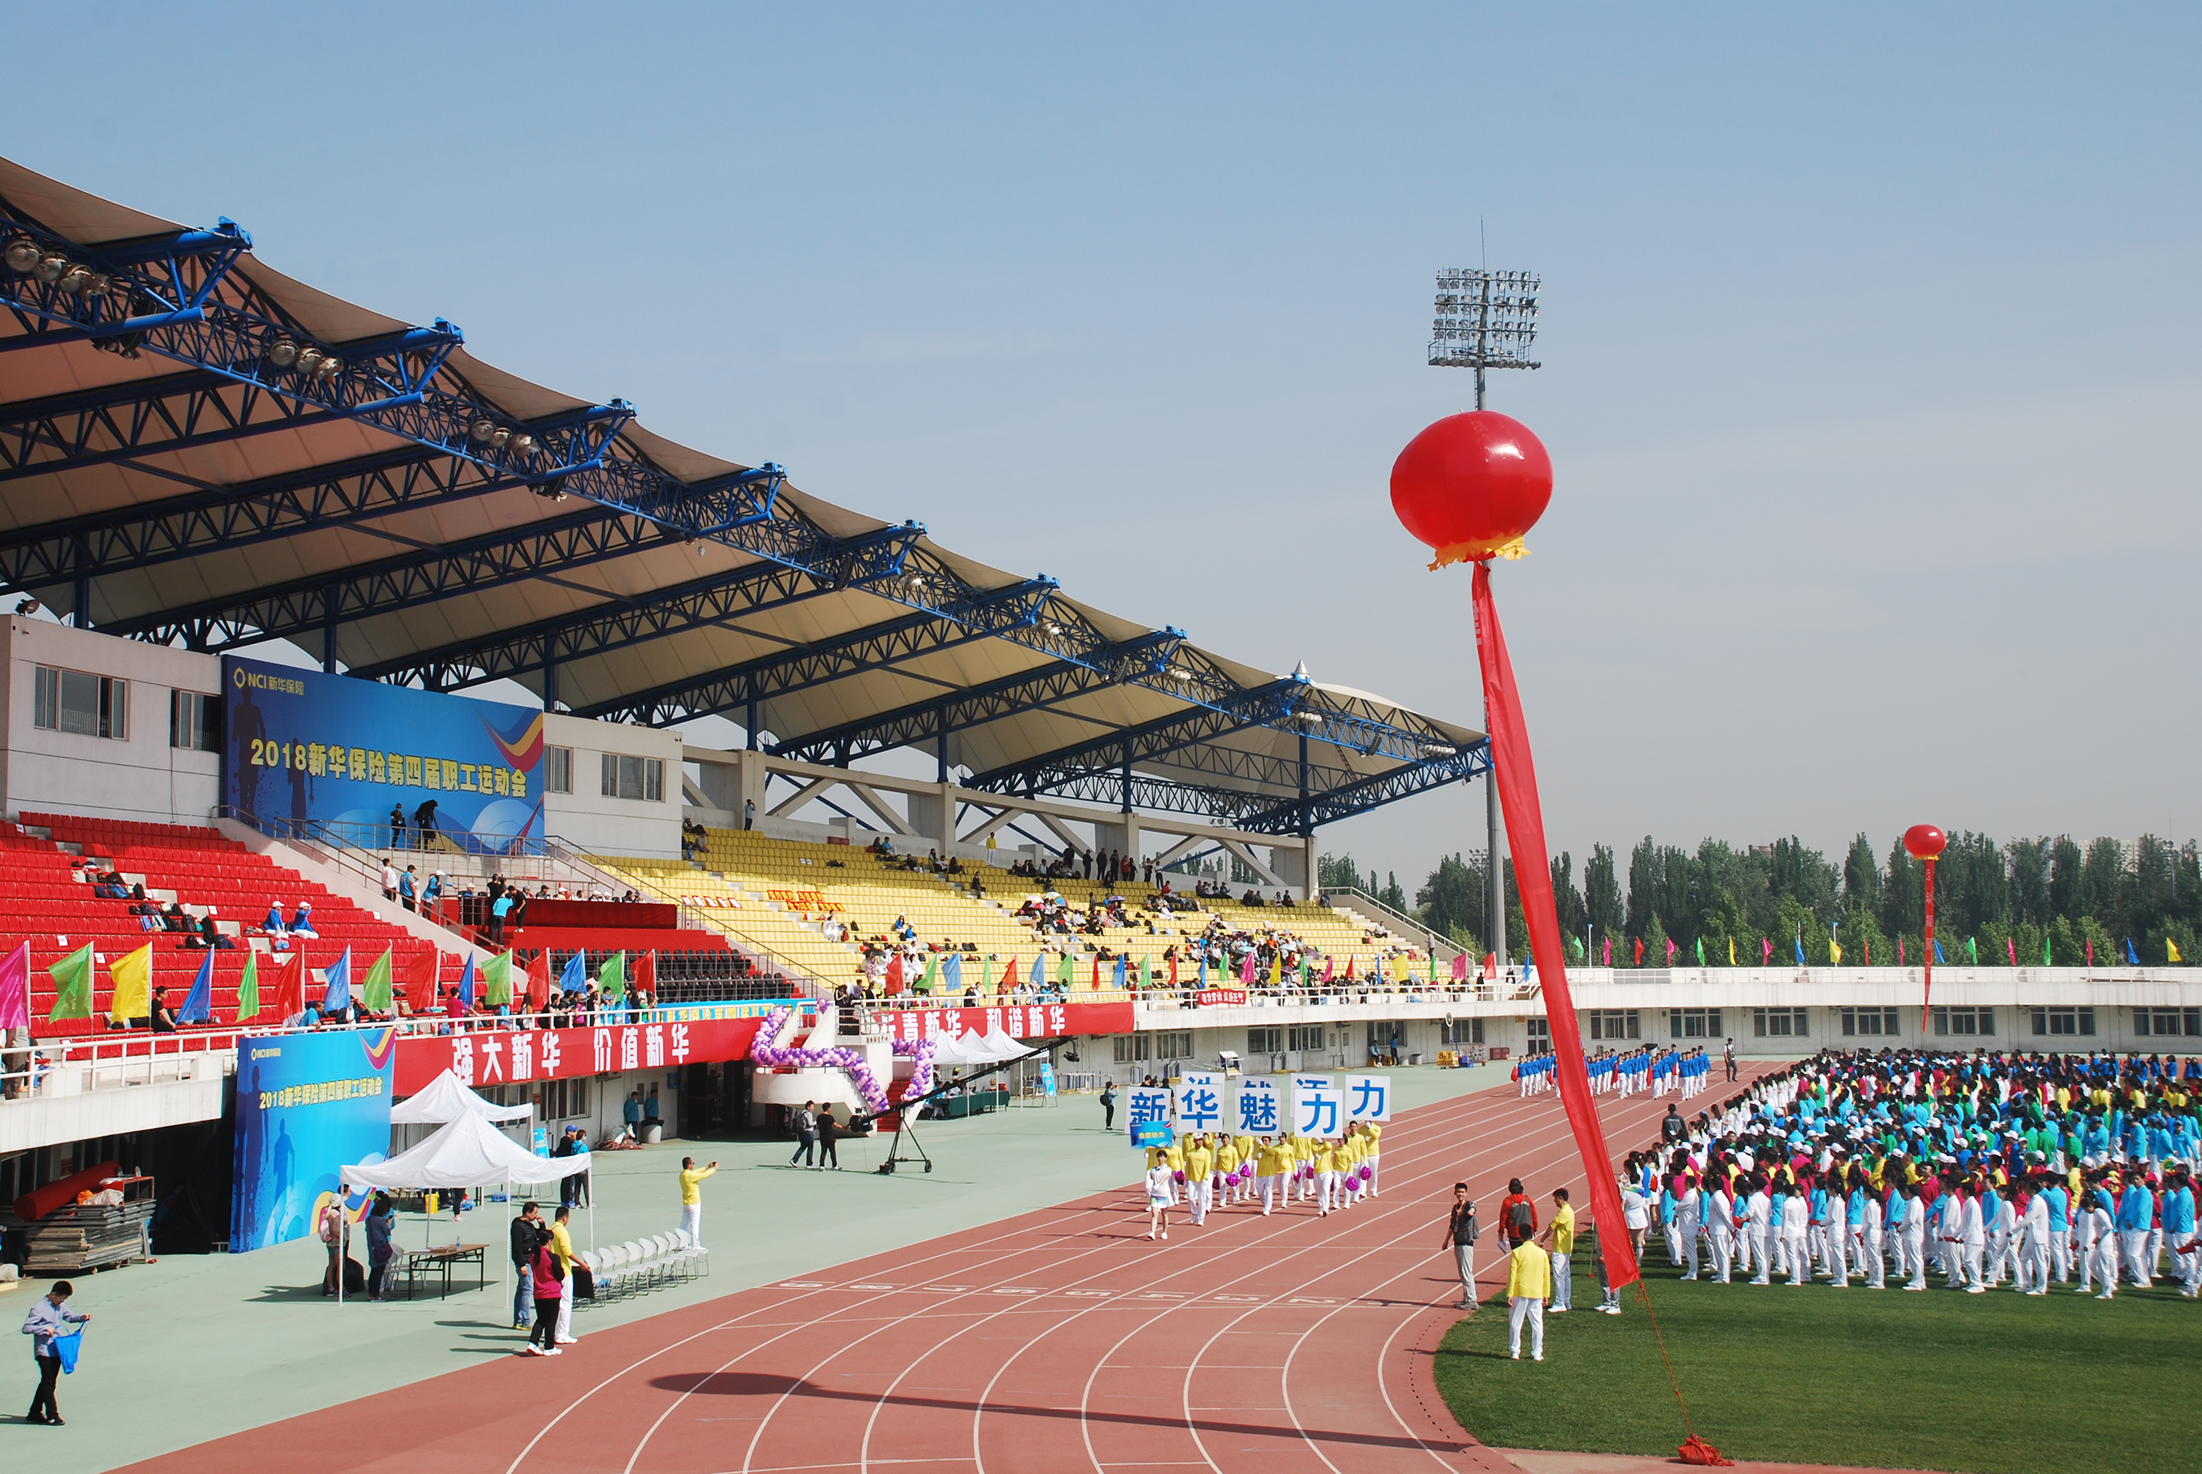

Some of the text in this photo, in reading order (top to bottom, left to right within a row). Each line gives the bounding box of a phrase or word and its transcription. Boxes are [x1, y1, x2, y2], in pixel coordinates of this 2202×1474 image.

[248, 672, 305, 696] NCI 新华保险
[250, 738, 528, 799] 2018新华保险第四届职工运动会
[986, 1004, 1066, 1038] 和谐新华
[452, 1023, 690, 1086] 强大新华 价值新华
[259, 1076, 382, 1109] 2018新华保险第四届职工运动会
[1352, 1080, 1385, 1117] 力
